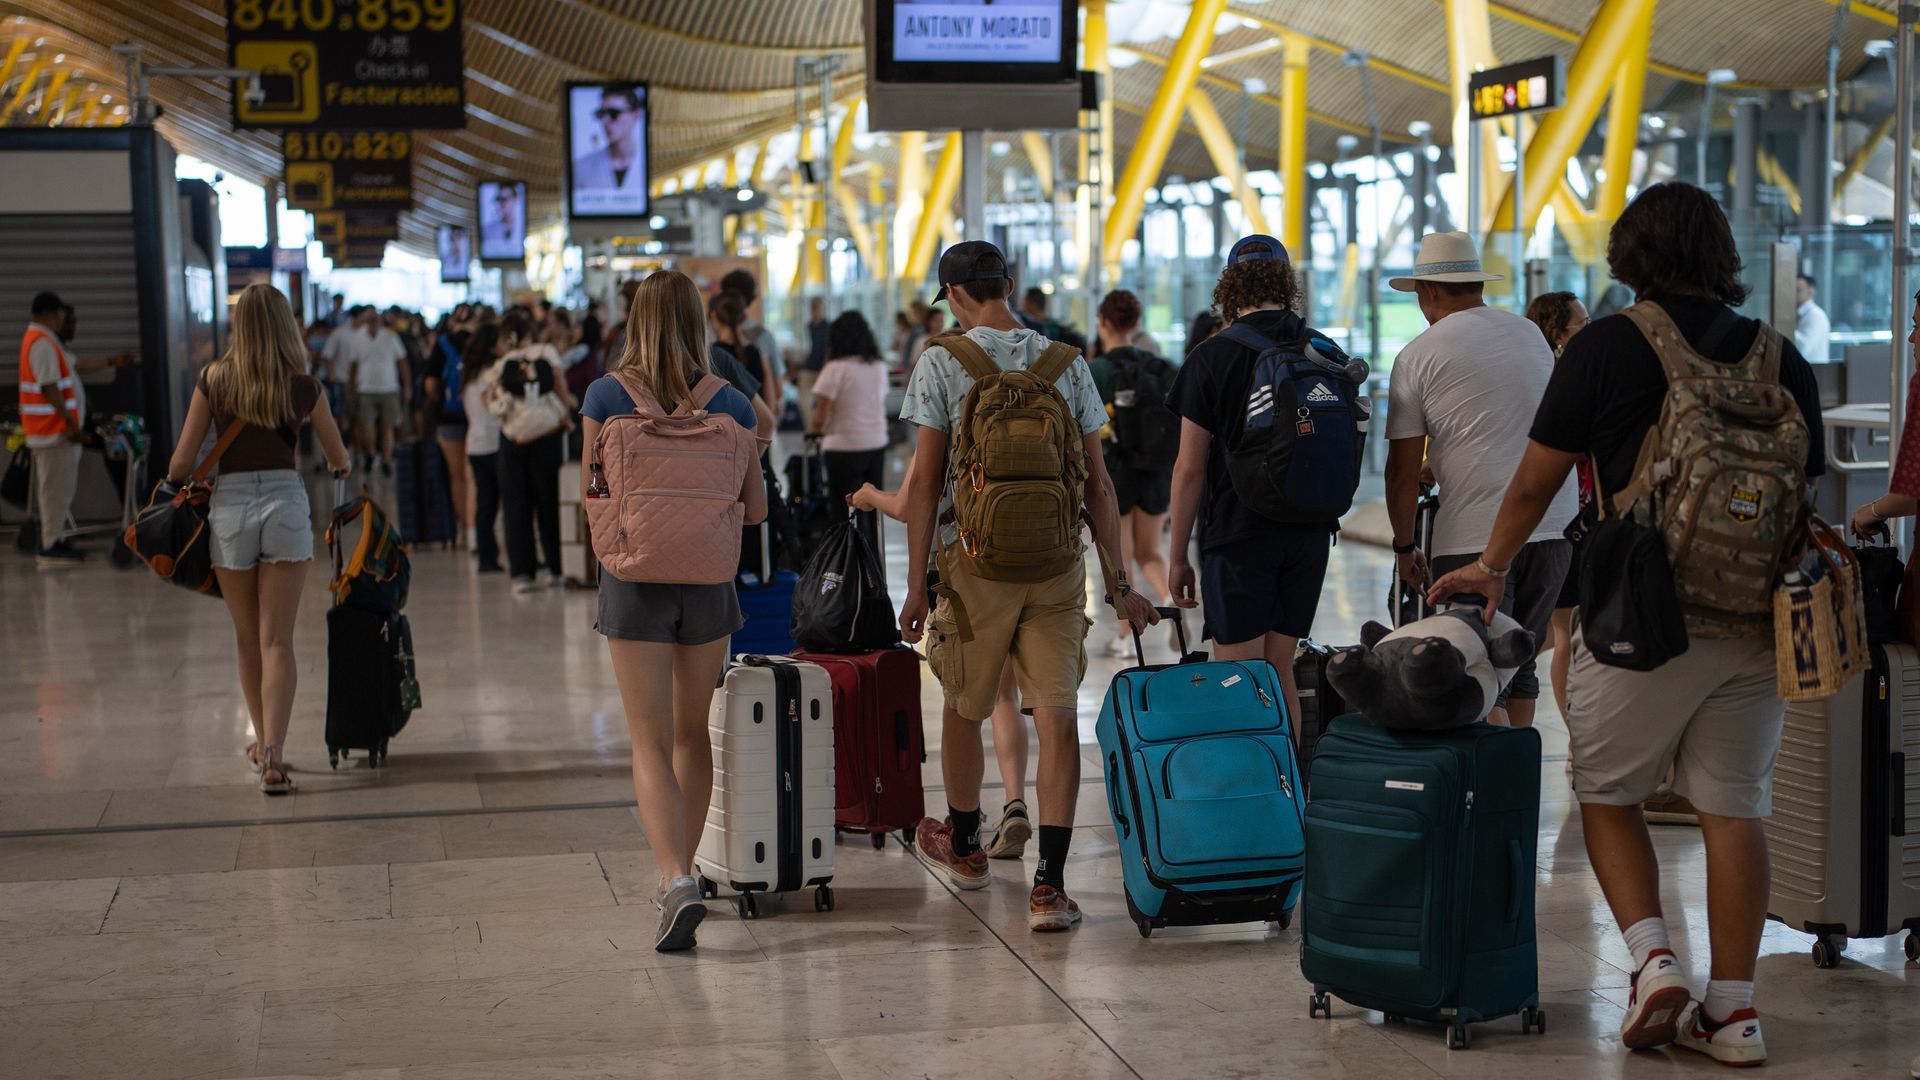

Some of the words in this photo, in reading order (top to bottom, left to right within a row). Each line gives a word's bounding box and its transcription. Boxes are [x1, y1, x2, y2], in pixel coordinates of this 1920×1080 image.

[233, 0, 334, 31] 840
[356, 0, 455, 31] 859
[905, 16, 974, 37] ANTONY
[981, 16, 1051, 38] MORATO
[355, 60, 429, 80] Check-in
[326, 81, 459, 105] Facturación
[285, 131, 342, 160] 810
[352, 131, 409, 160] 829
